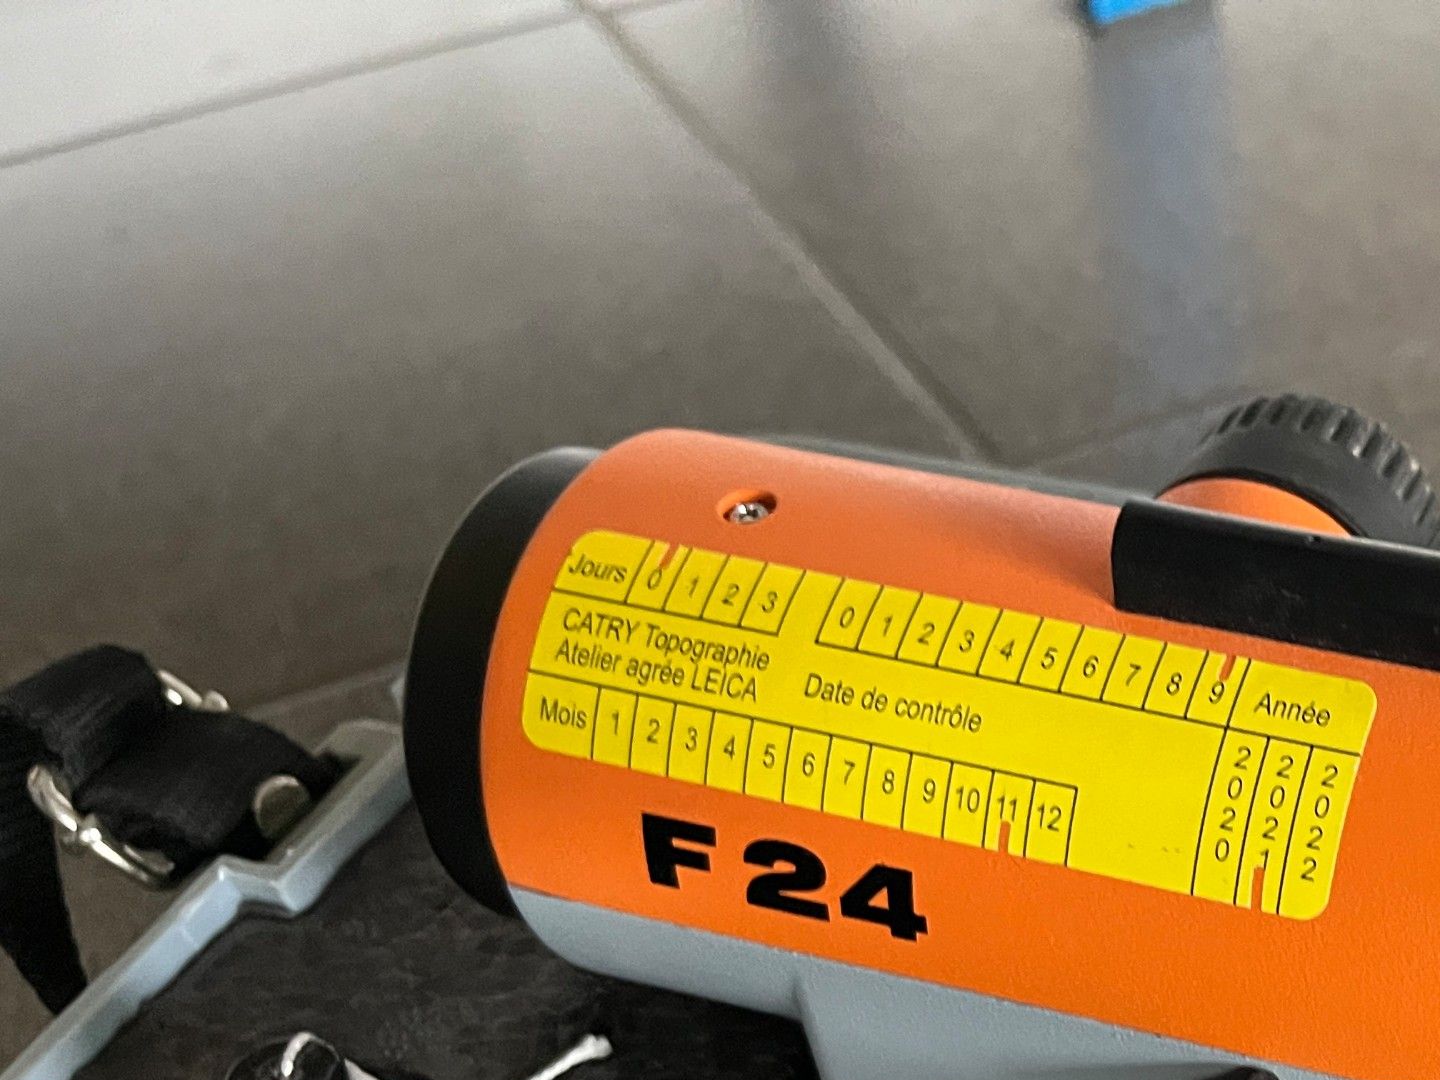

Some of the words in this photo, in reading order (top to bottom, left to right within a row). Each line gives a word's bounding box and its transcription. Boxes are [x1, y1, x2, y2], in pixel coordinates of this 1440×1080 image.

[563, 608, 640, 644] CATRY
[645, 622, 771, 672] Topographie
[568, 551, 629, 584] Jours
[647, 567, 662, 590] 0
[720, 584, 739, 605] 2
[761, 590, 778, 613] 3
[839, 606, 855, 629] 0
[917, 623, 935, 645] 2
[959, 630, 976, 653] 3
[999, 638, 1015, 661] 4
[1041, 647, 1060, 670] 5
[1083, 655, 1099, 678] 6
[1127, 664, 1142, 687] 7
[1166, 673, 1182, 696] 8
[1208, 681, 1225, 705] 9
[555, 637, 619, 673] Atelier
[626, 657, 685, 689] agrée
[690, 669, 758, 702] LEICA
[804, 672, 855, 706] Date
[861, 685, 889, 712] de
[894, 694, 983, 733] contrôle
[1253, 692, 1331, 727] Année
[539, 695, 588, 730] Mois
[610, 712, 620, 736] 1
[646, 718, 660, 744] 2
[684, 728, 698, 753] 3
[723, 736, 737, 760] 4
[762, 744, 777, 770] 5
[801, 752, 816, 778] 6
[841, 761, 856, 785] 7
[881, 770, 896, 796] 8
[922, 778, 937, 804] 9
[955, 786, 981, 815] 10
[996, 795, 1018, 822] 11
[1036, 803, 1062, 832] 12
[641, 811, 717, 890] F
[743, 838, 929, 942] 24
